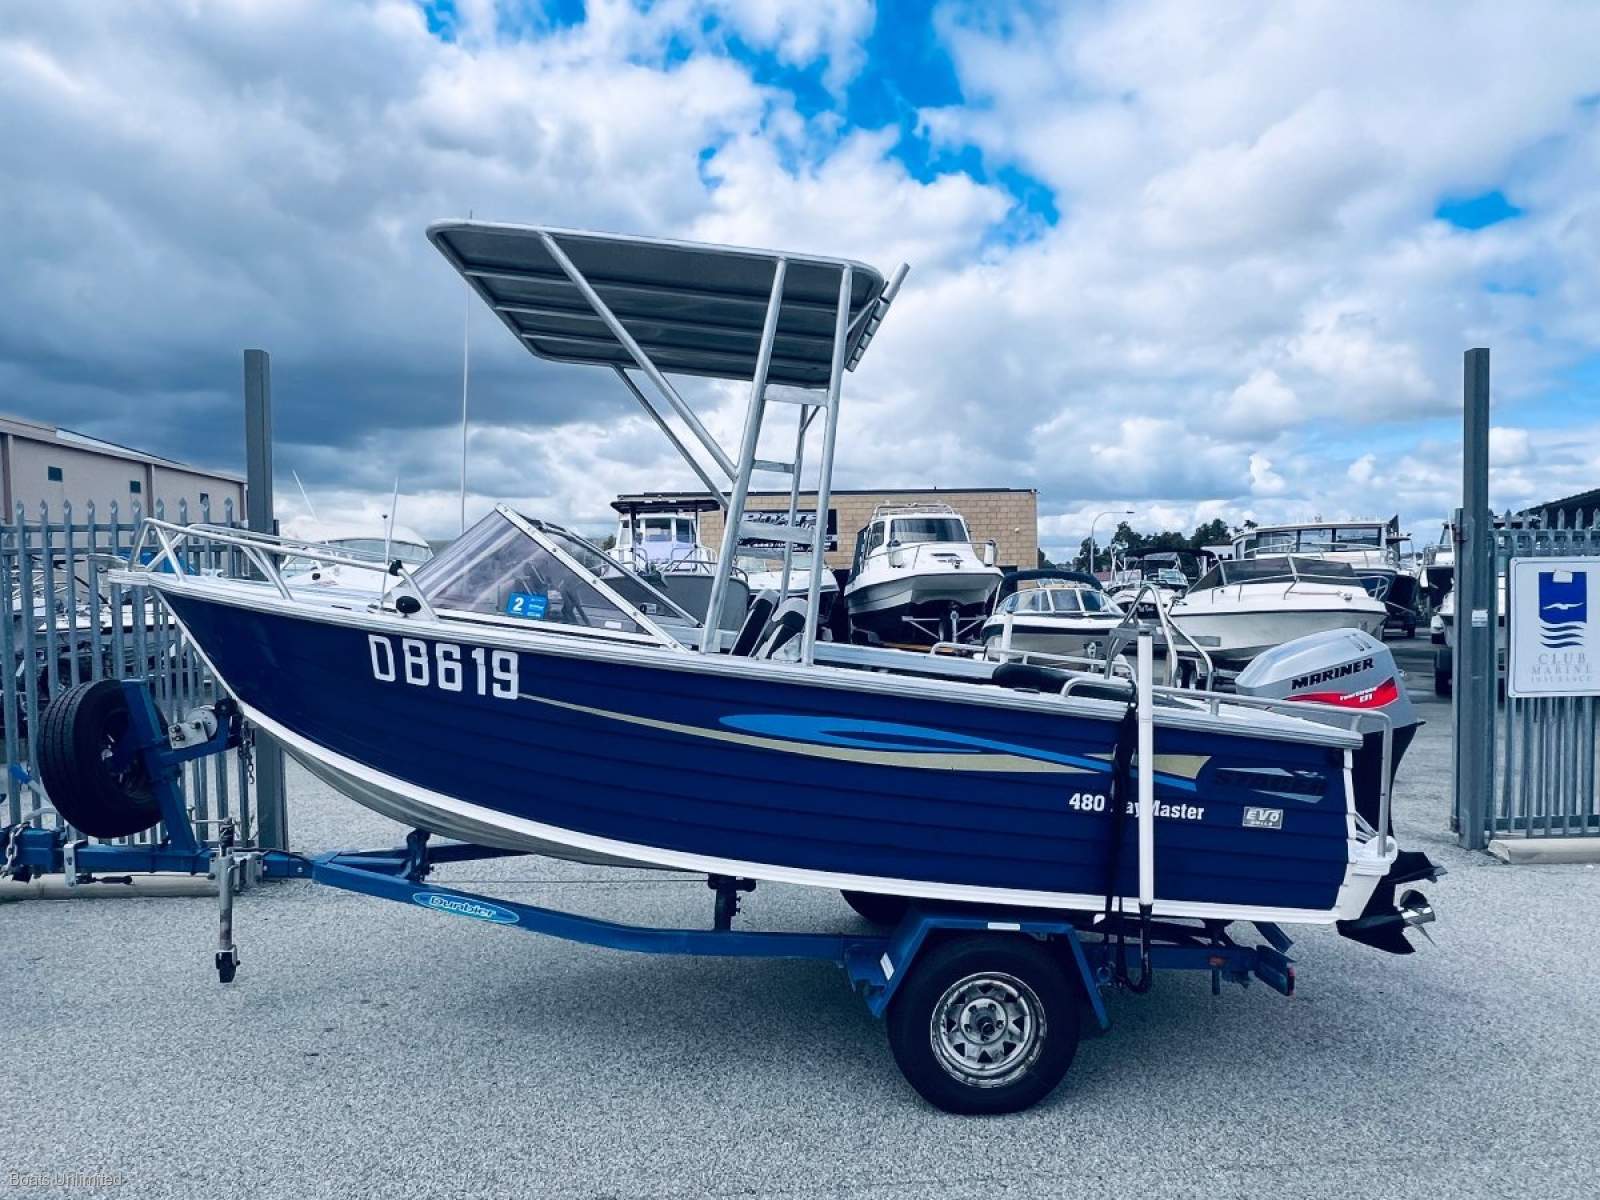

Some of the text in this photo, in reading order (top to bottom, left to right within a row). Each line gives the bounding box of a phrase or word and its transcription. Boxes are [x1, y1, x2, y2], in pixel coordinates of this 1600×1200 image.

[513, 597, 525, 612] 2
[1538, 652, 1586, 665] CLUB
[1291, 657, 1374, 690] MARINER
[1069, 793, 1105, 812] 480
